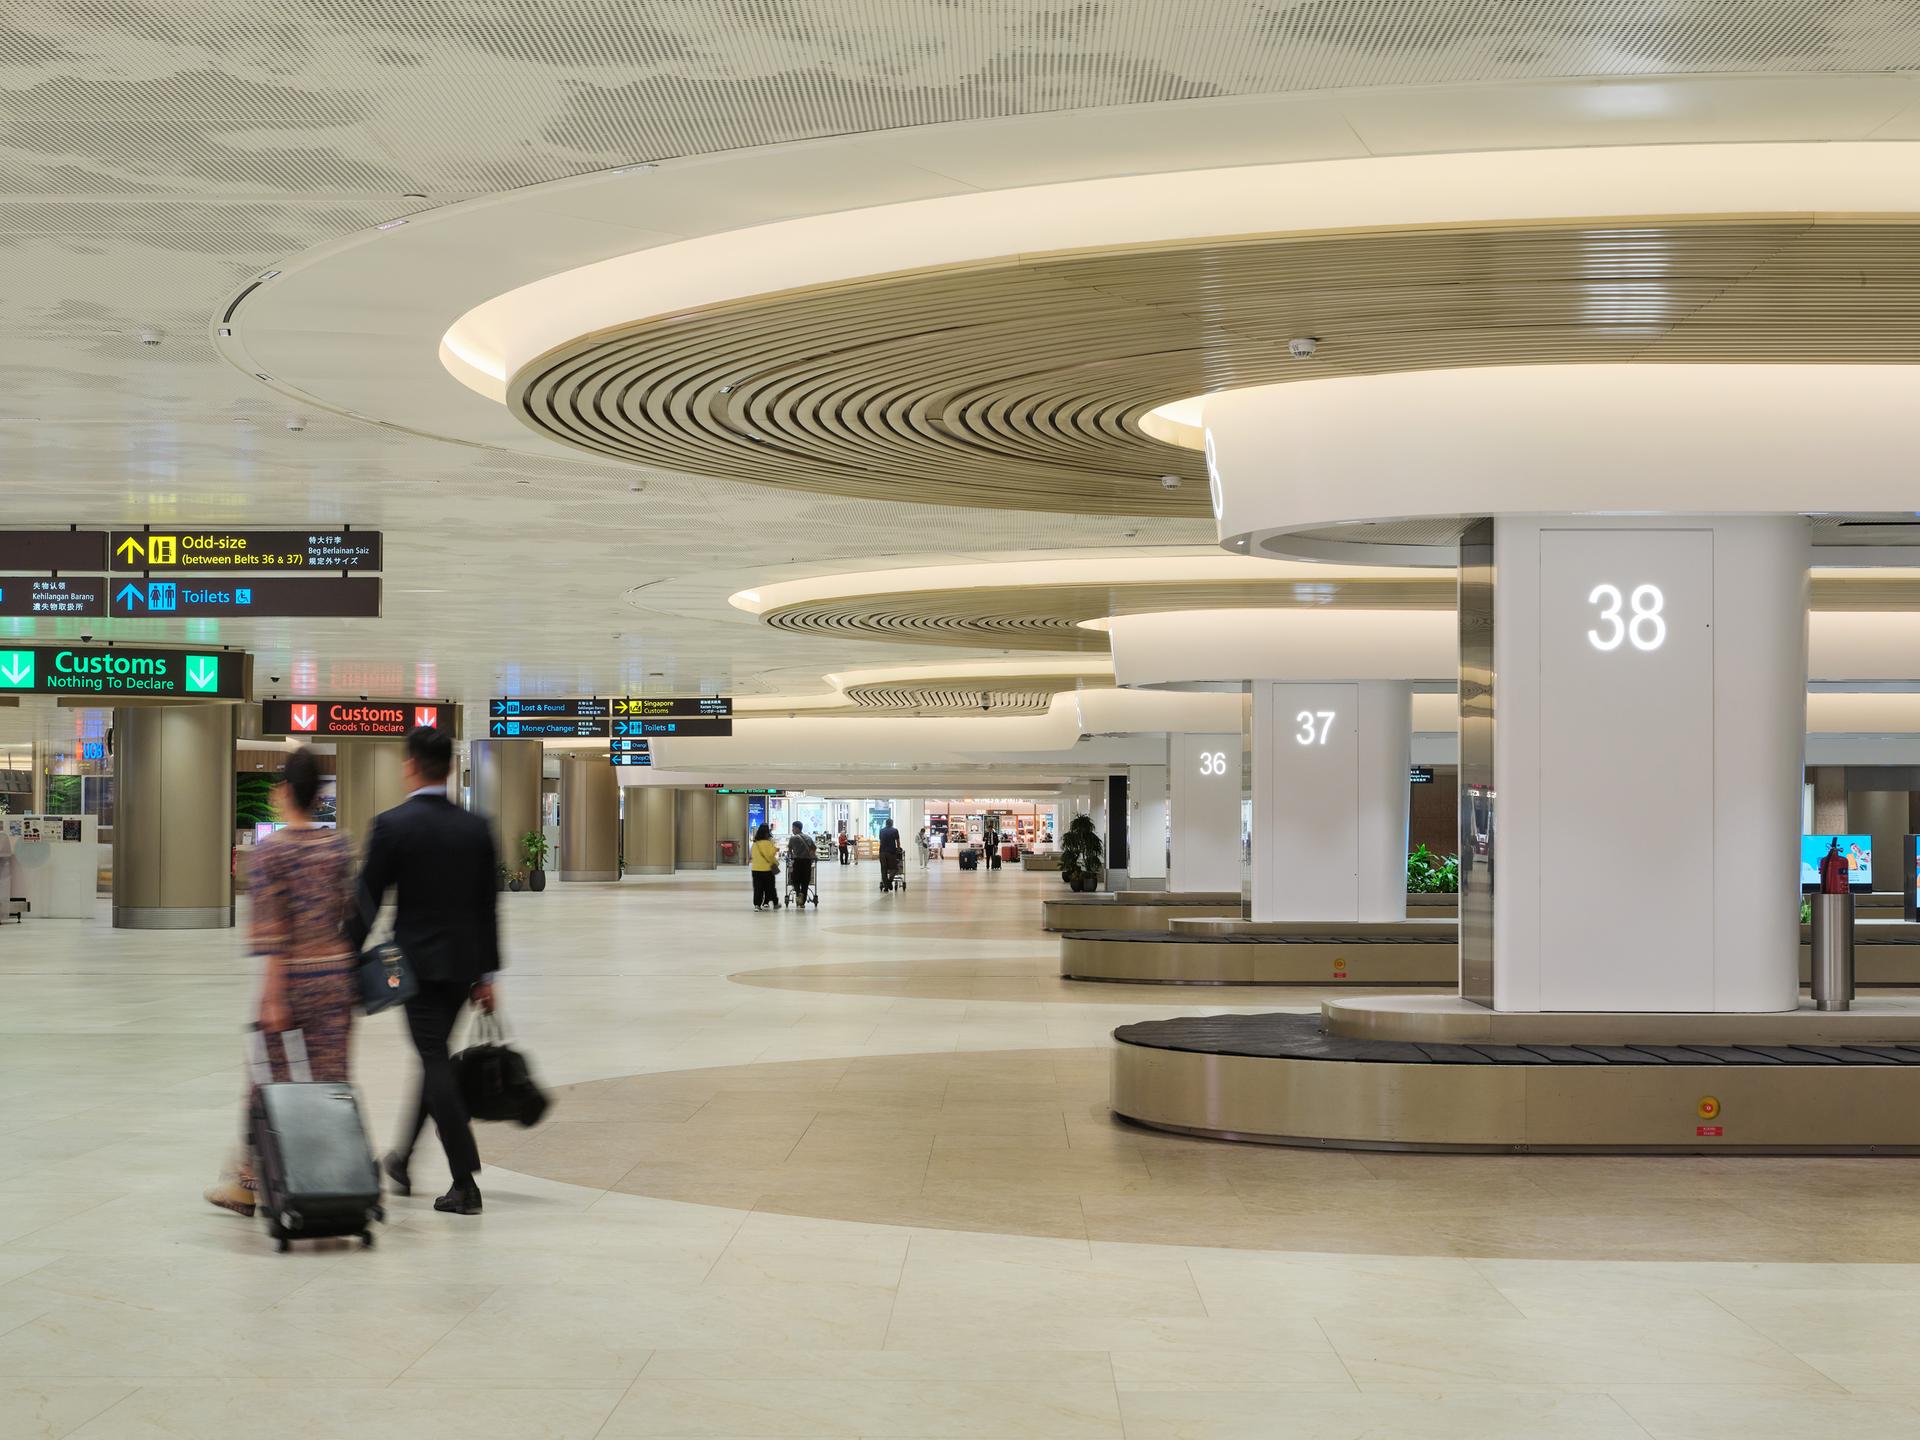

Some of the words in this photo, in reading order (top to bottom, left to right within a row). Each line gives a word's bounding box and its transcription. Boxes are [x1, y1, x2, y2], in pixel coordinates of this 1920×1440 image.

[182, 535, 247, 549] Odd-size
[308, 547, 321, 556] Beg
[356, 547, 370, 555] Saiz
[182, 554, 231, 565] (between
[234, 554, 260, 564] Belts
[262, 554, 275, 565] 36
[277, 556, 284, 564] &
[286, 554, 303, 565] 37)
[308, 557, 359, 566] 規定外サイズ
[32, 593, 69, 602] Kehilangan
[71, 593, 95, 602] Barang
[181, 589, 230, 603] Toilets
[1588, 584, 1666, 651] 38
[55, 651, 167, 675] Customs
[47, 675, 103, 690] Nothing
[106, 677, 122, 688] To
[126, 677, 174, 690] Declare
[643, 700, 674, 709] Singapore
[330, 705, 404, 722] Customs
[328, 722, 358, 732] Goods
[360, 722, 370, 732] To
[372, 723, 405, 733] Declare
[521, 725, 545, 733] Money
[546, 725, 575, 733] Changer
[644, 724, 666, 732] Toilets
[1296, 711, 1335, 746] 37
[83, 742, 104, 759] UOB
[1200, 752, 1226, 775] 36
